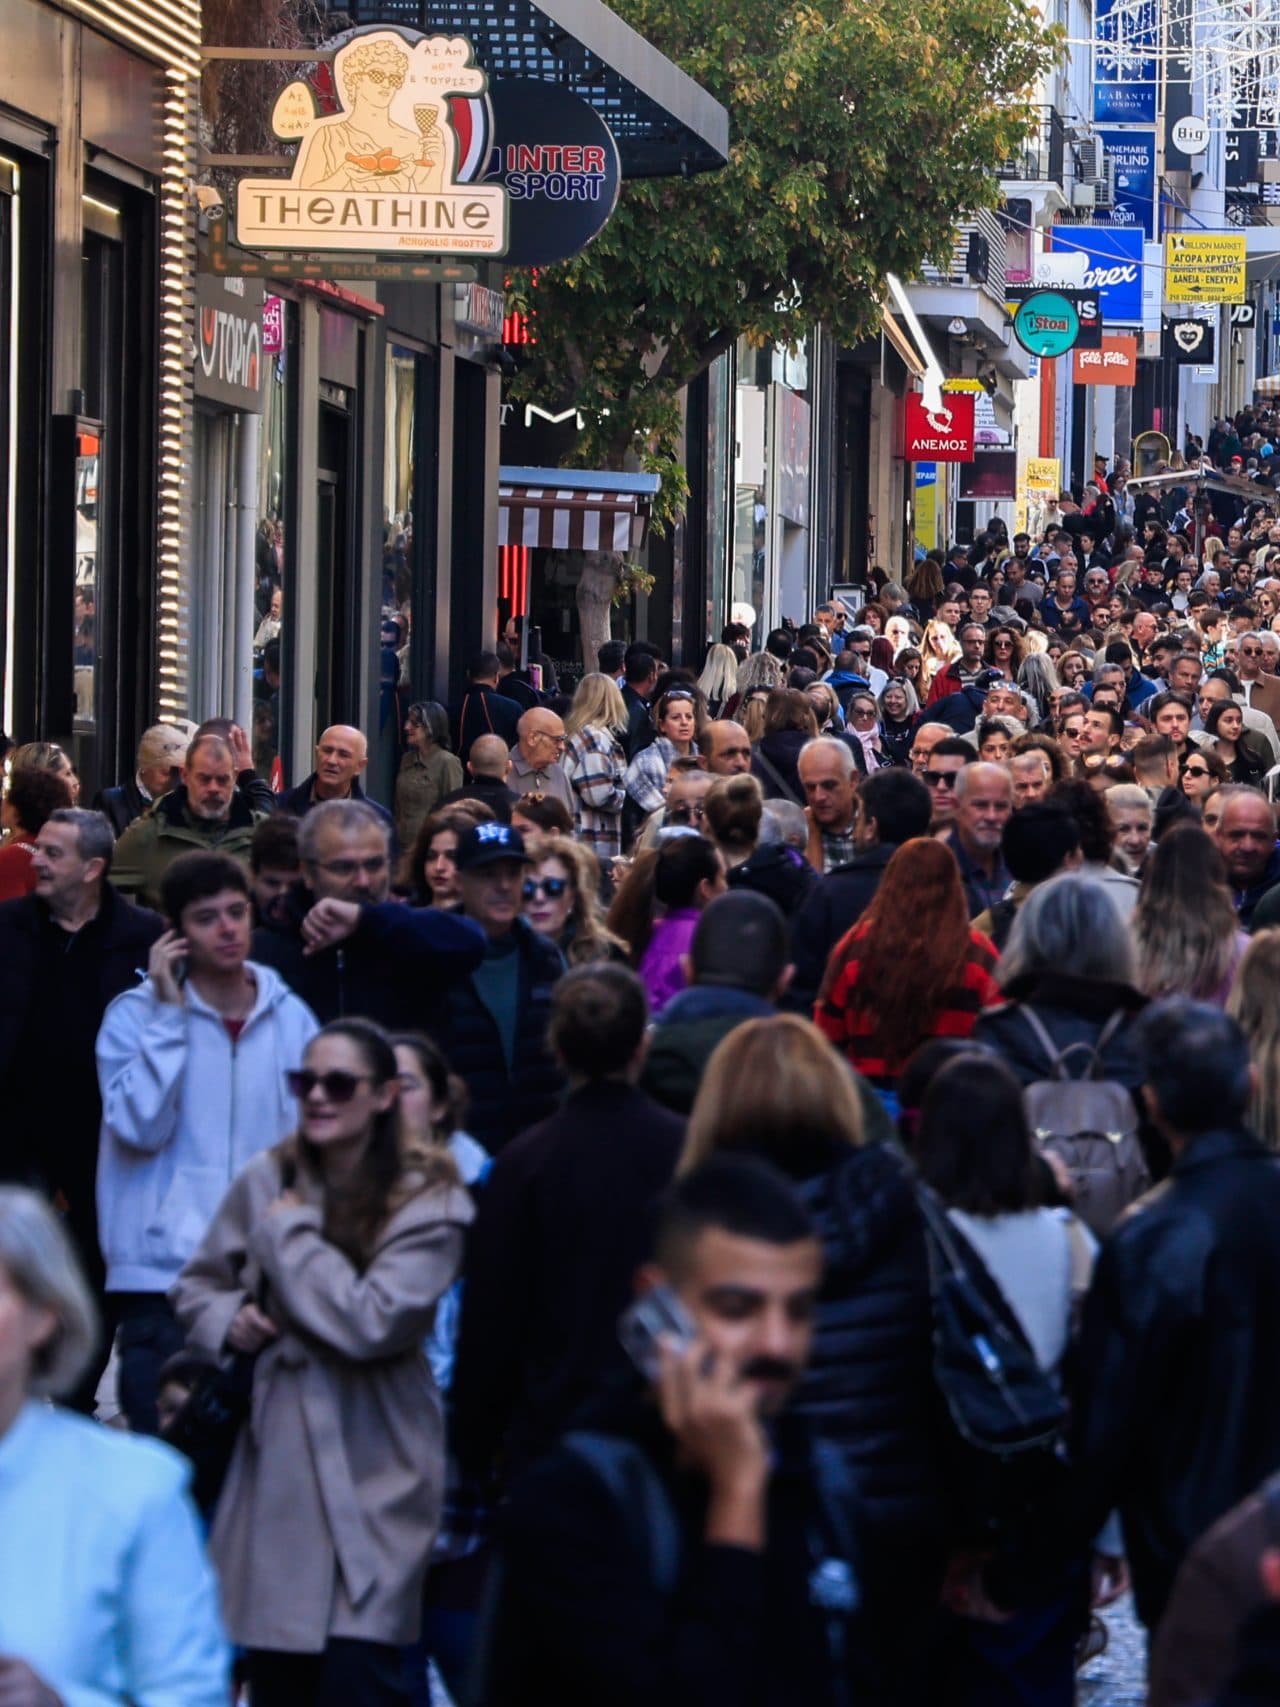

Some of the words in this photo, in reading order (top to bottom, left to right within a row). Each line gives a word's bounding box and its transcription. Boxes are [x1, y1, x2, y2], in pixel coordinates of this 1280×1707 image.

[1105, 145, 1148, 154] NNEMARIE
[507, 144, 605, 172] INTER
[505, 172, 605, 200] SPORT
[1213, 242, 1241, 250] MARKET
[1174, 254, 1203, 263] ΑΓΟΡΑ
[1205, 255, 1240, 264] ΧΡΥΣΟΥ
[1173, 275, 1200, 284] ΔΑΝΕΙΑ
[1205, 275, 1239, 285] ΕΝΕΧΥΡΑ
[1029, 315, 1067, 330] iStoa
[1080, 351, 1102, 368] Folli
[1103, 351, 1129, 367] Follie
